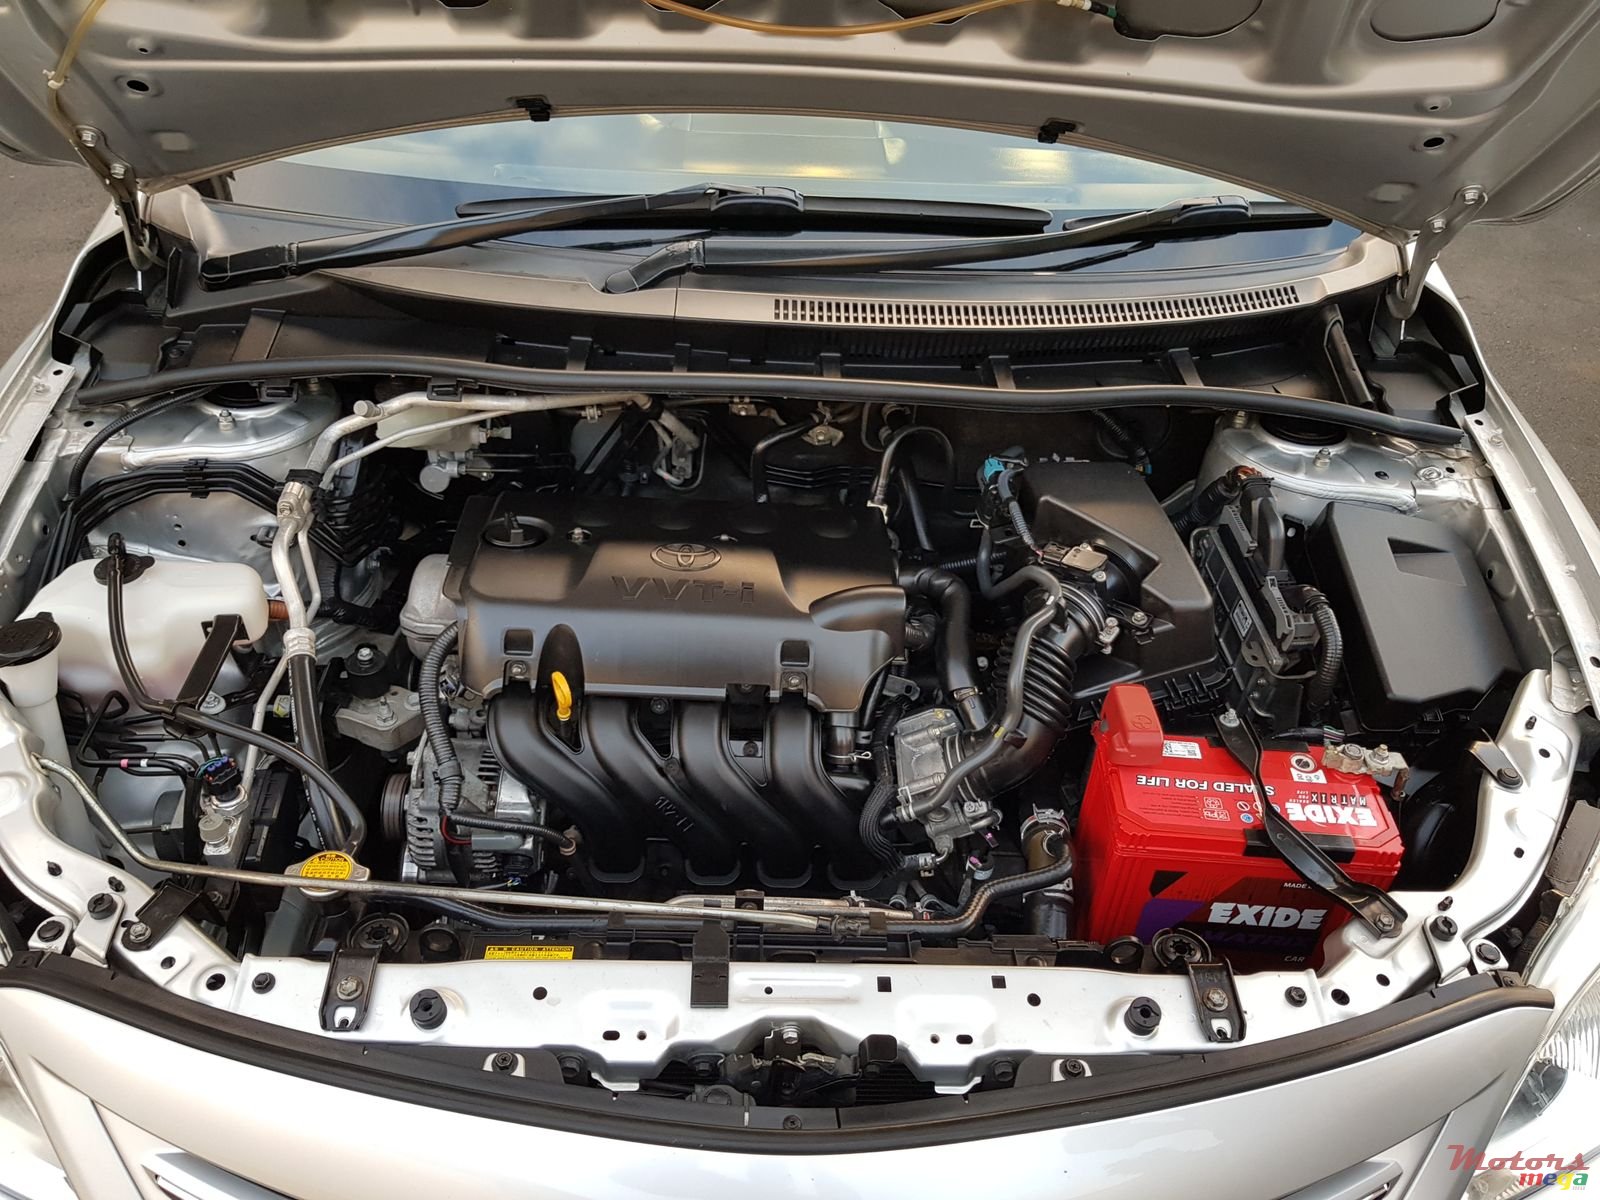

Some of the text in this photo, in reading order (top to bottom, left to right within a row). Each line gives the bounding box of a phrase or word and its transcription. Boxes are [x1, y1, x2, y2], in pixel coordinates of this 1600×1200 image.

[611, 576, 755, 603] VVT-i
[1136, 774, 1275, 796] SALED FOR LIFE
[1311, 792, 1367, 806] MATRIX
[1285, 801, 1377, 827] EXIDE
[1208, 902, 1328, 930] EXIDE
